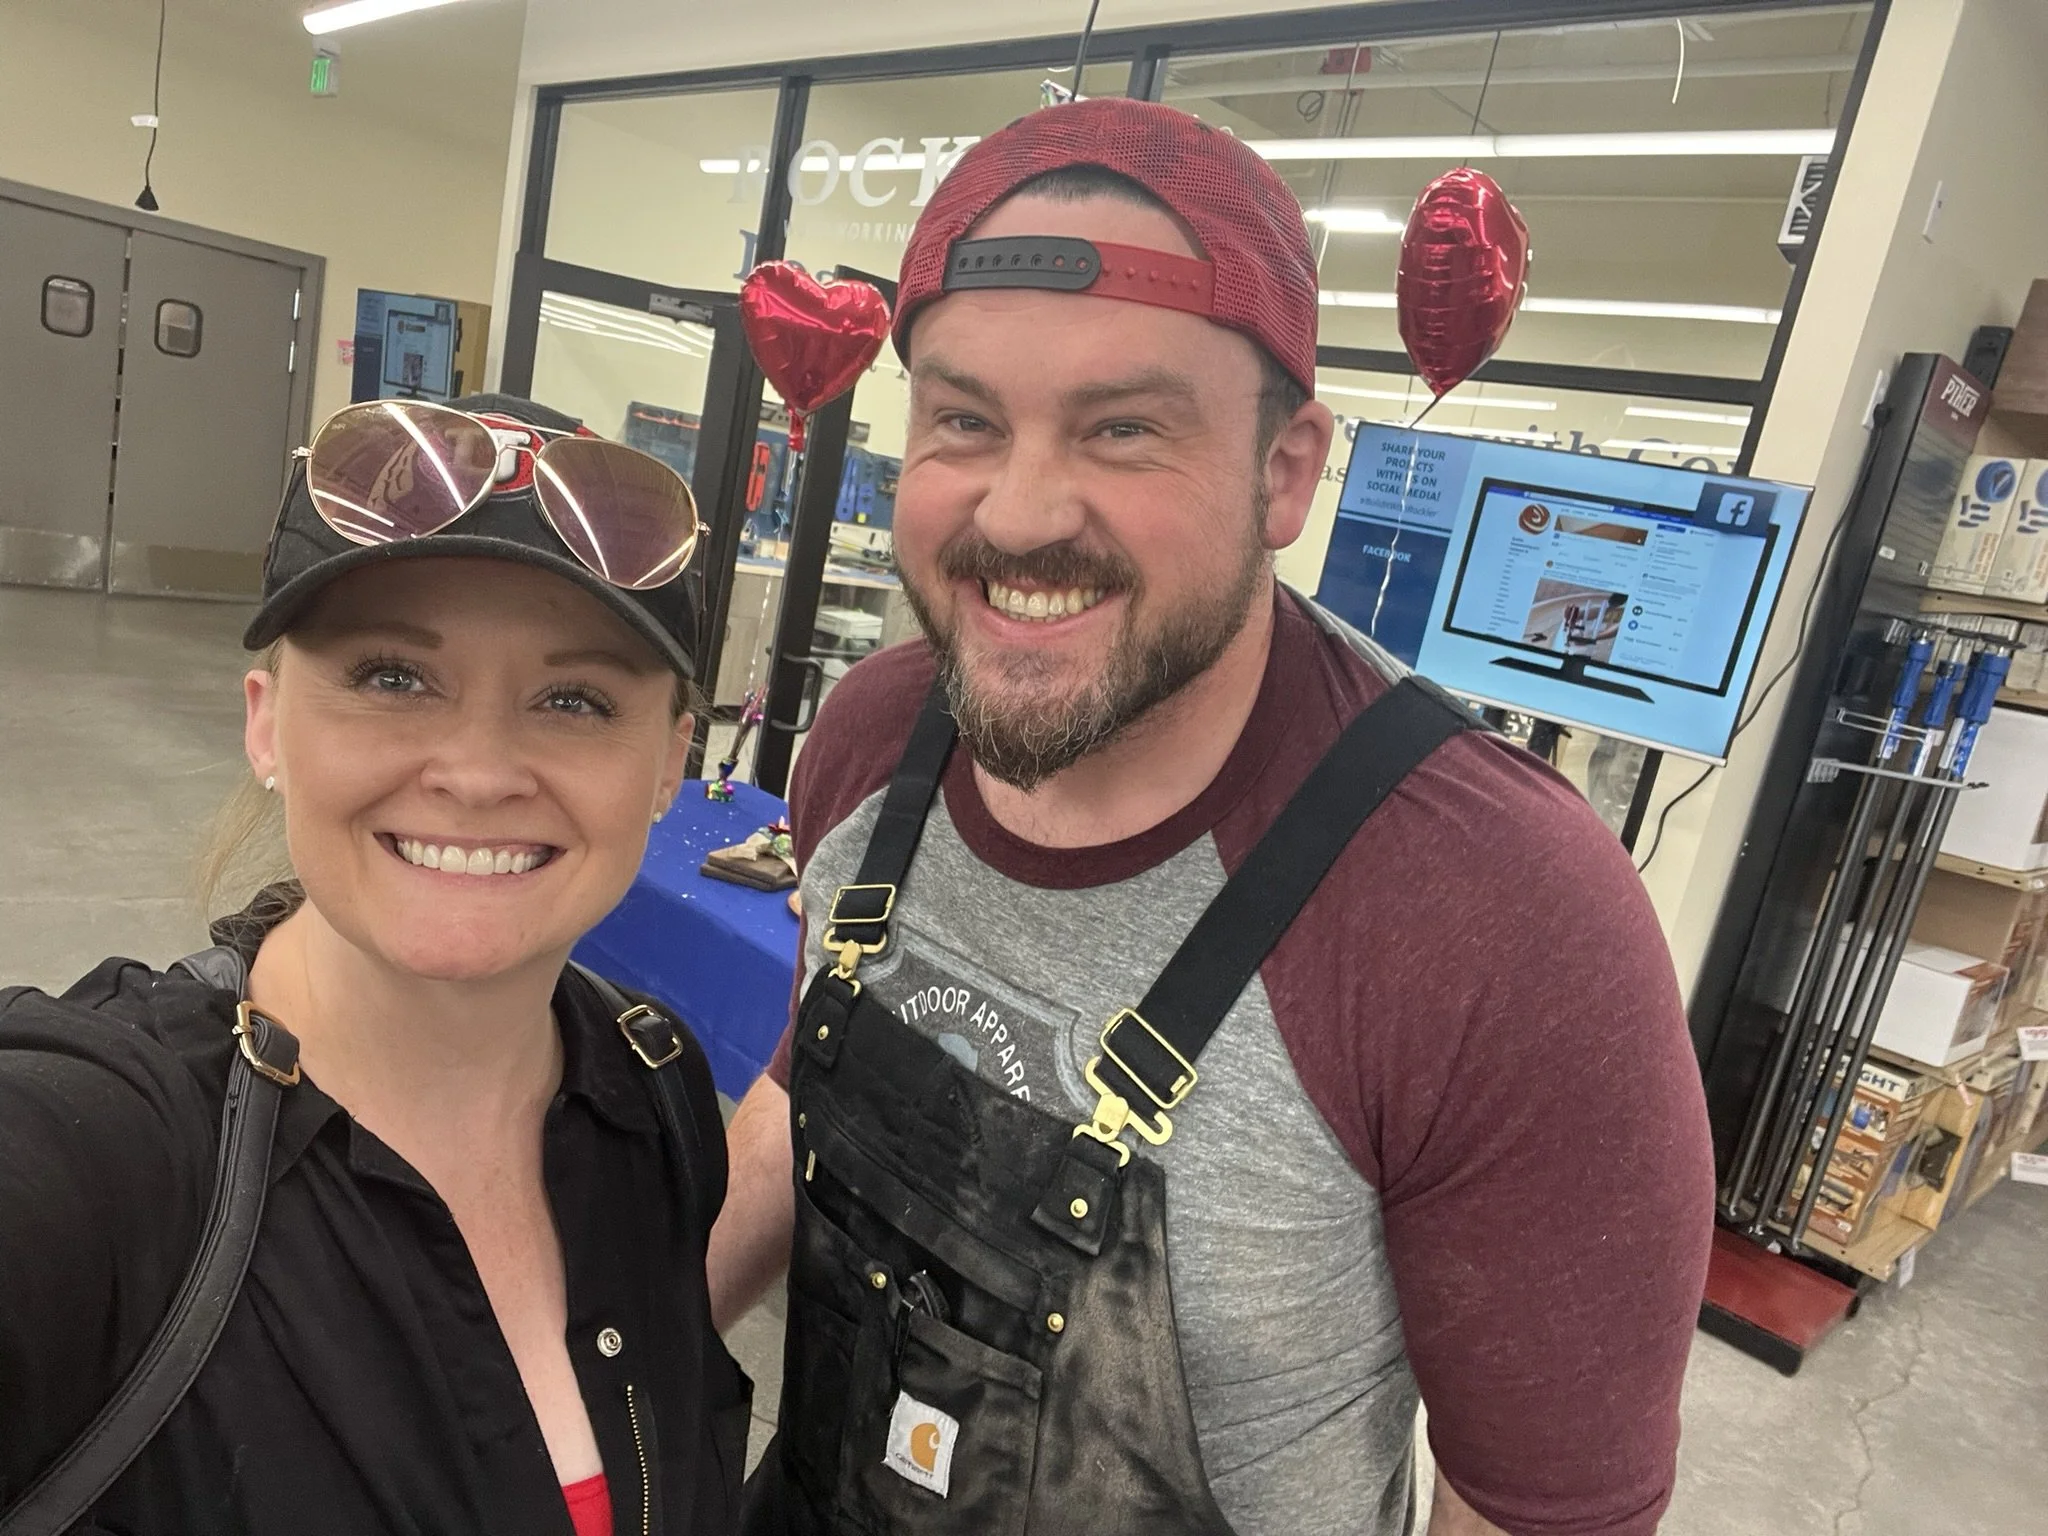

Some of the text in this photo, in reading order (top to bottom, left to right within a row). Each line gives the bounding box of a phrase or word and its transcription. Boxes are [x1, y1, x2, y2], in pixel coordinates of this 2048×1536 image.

[1417, 447, 1446, 461] YOUR
[1385, 456, 1434, 473] PROJCTS
[1376, 468, 1402, 481] WITH
[1421, 476, 1438, 488] ON
[1366, 481, 1400, 496] SOCIAL
